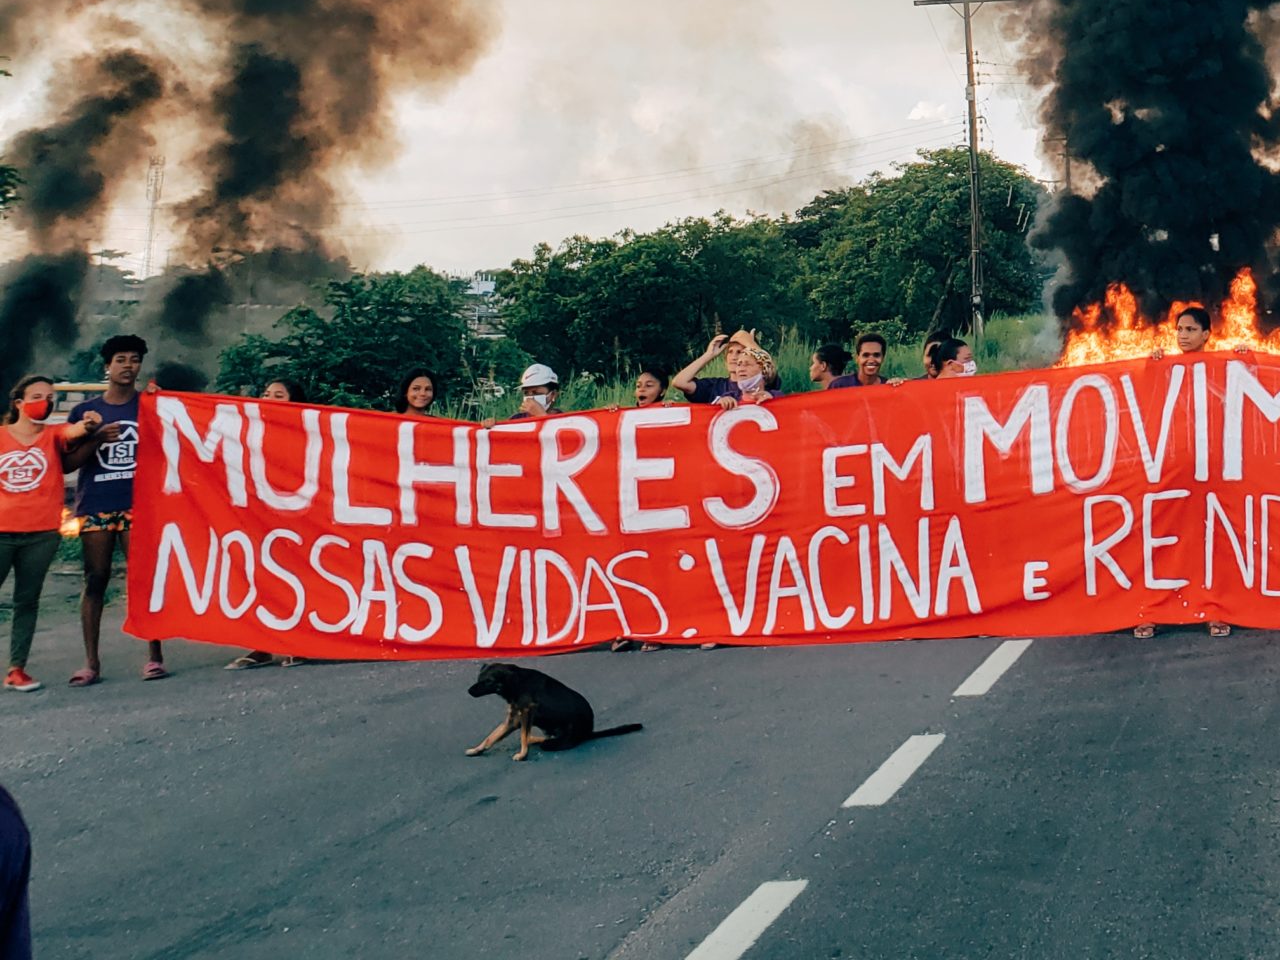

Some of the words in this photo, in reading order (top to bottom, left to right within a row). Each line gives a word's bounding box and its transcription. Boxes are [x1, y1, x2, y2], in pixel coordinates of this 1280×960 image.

[156, 396, 781, 534] MULHERES
[822, 433, 934, 517] EM
[149, 522, 443, 642] NOSSAS
[705, 515, 982, 636] VACINA
[1023, 561, 1049, 601] E
